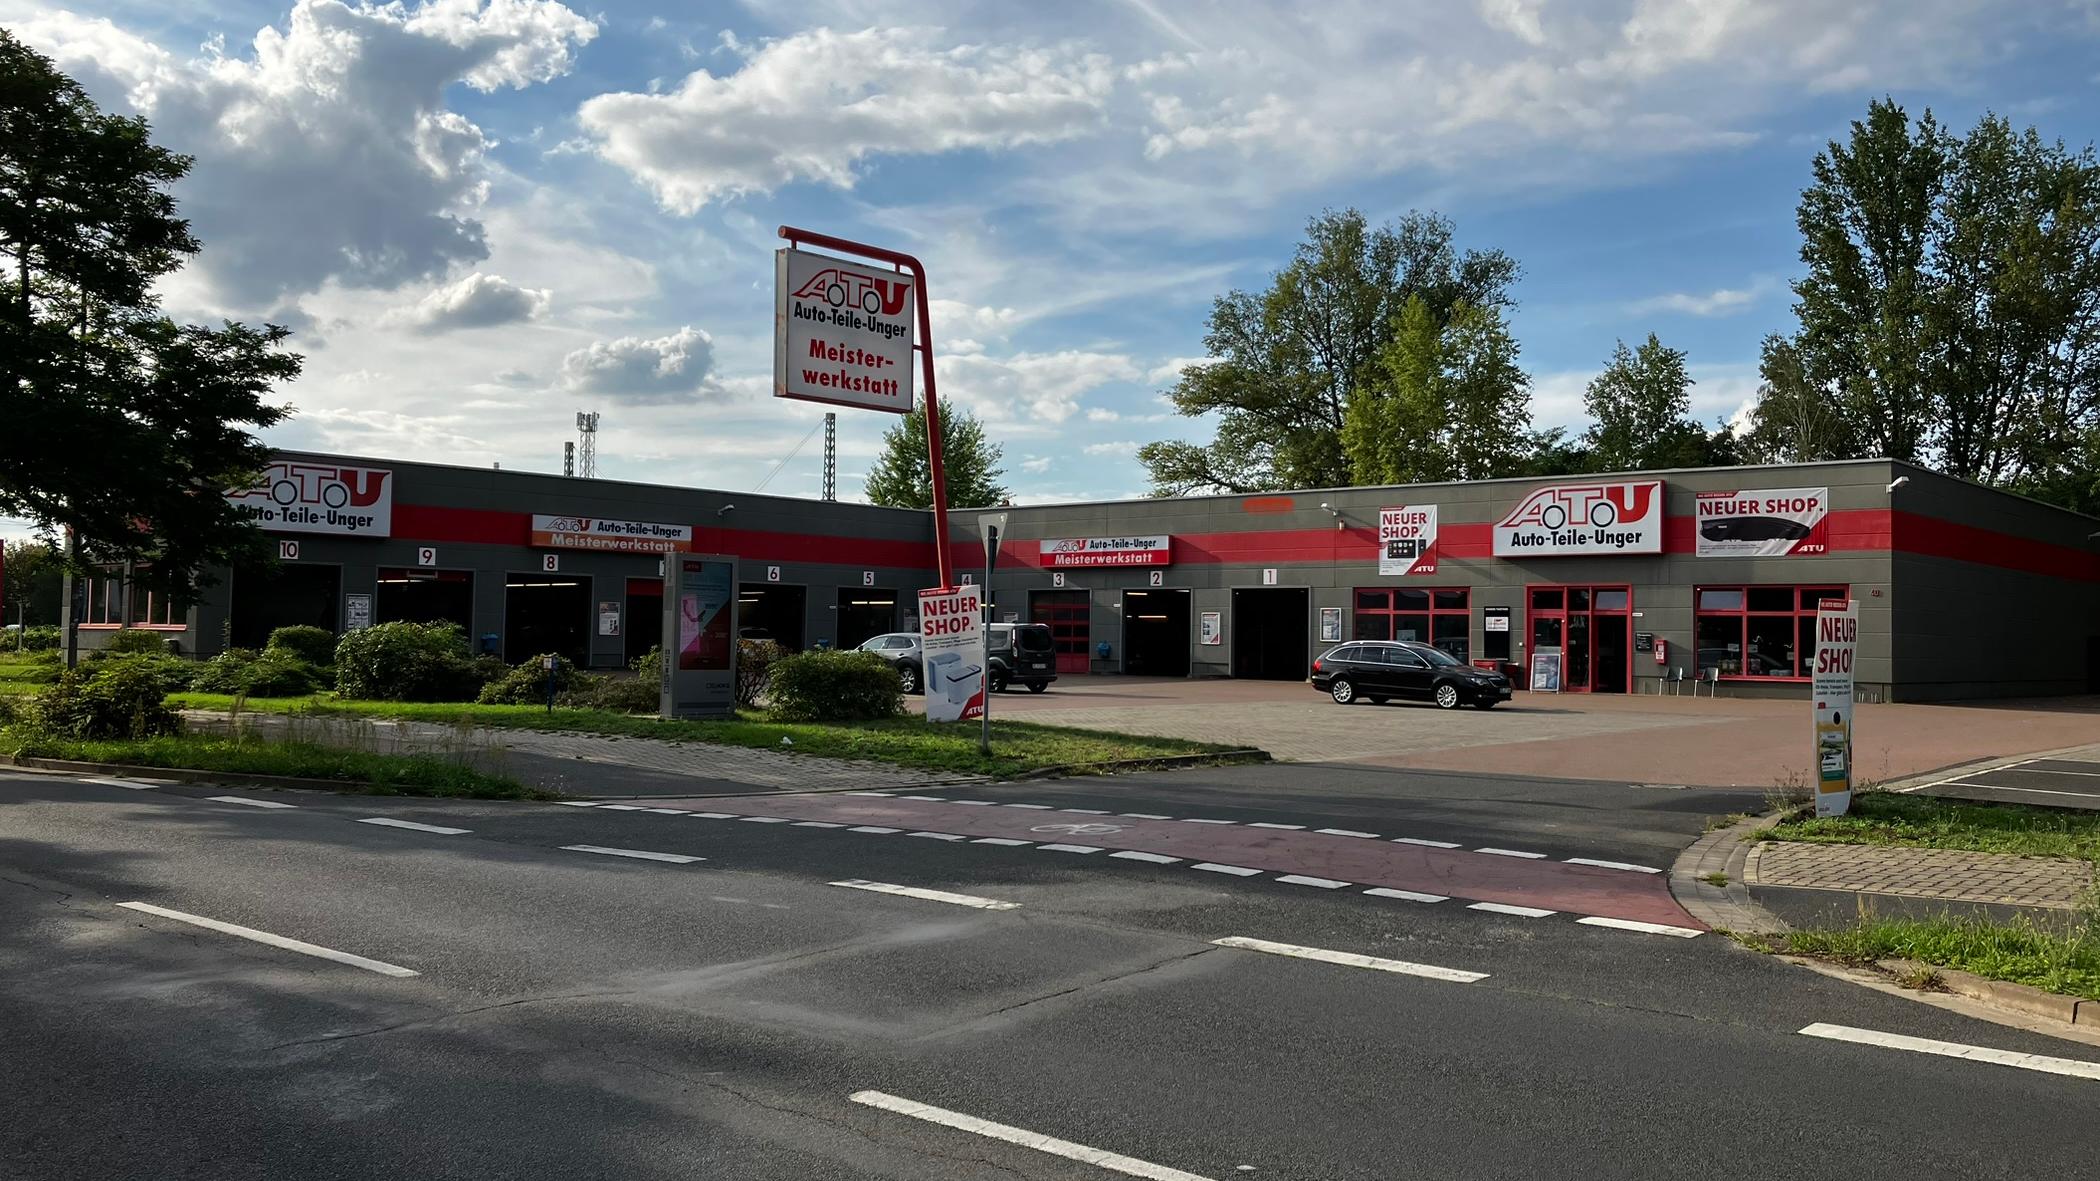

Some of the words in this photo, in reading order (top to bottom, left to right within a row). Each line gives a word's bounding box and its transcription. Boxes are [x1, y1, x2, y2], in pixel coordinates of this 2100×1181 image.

[791, 269, 911, 315] ATU
[794, 301, 906, 340] Auto-Teile-Unger
[809, 339, 894, 369] Meister-
[802, 369, 898, 396] werkstatt
[1500, 483, 1658, 529] ATU
[1699, 500, 1760, 515] NEUER
[1765, 498, 1823, 513] SHOP.
[1382, 513, 1427, 525] NEUER
[545, 517, 592, 532] ATU
[597, 521, 682, 538] Auto-Teile-Unger
[1382, 526, 1423, 538] SHOP.
[551, 533, 675, 551] Meisterwerkstatt
[1511, 529, 1642, 548] Auto-Teile-Unger
[281, 542, 298, 557] 10
[1052, 539, 1087, 552] ATU
[1089, 539, 1157, 550] Auto-Teile-Unger
[1797, 544, 1824, 552] ATU
[422, 550, 433, 563] 9
[546, 556, 555, 570] 8
[1055, 552, 1152, 565] Meisterwerkstatt
[769, 567, 778, 580] 6
[865, 572, 872, 584] 5
[1055, 574, 1062, 585] 3
[1152, 572, 1160, 585] 2
[1267, 570, 1272, 583] 1
[963, 576, 970, 585] 4
[923, 596, 978, 617] NEUER
[924, 616, 975, 636] SHOP.
[966, 705, 983, 716] ATU
